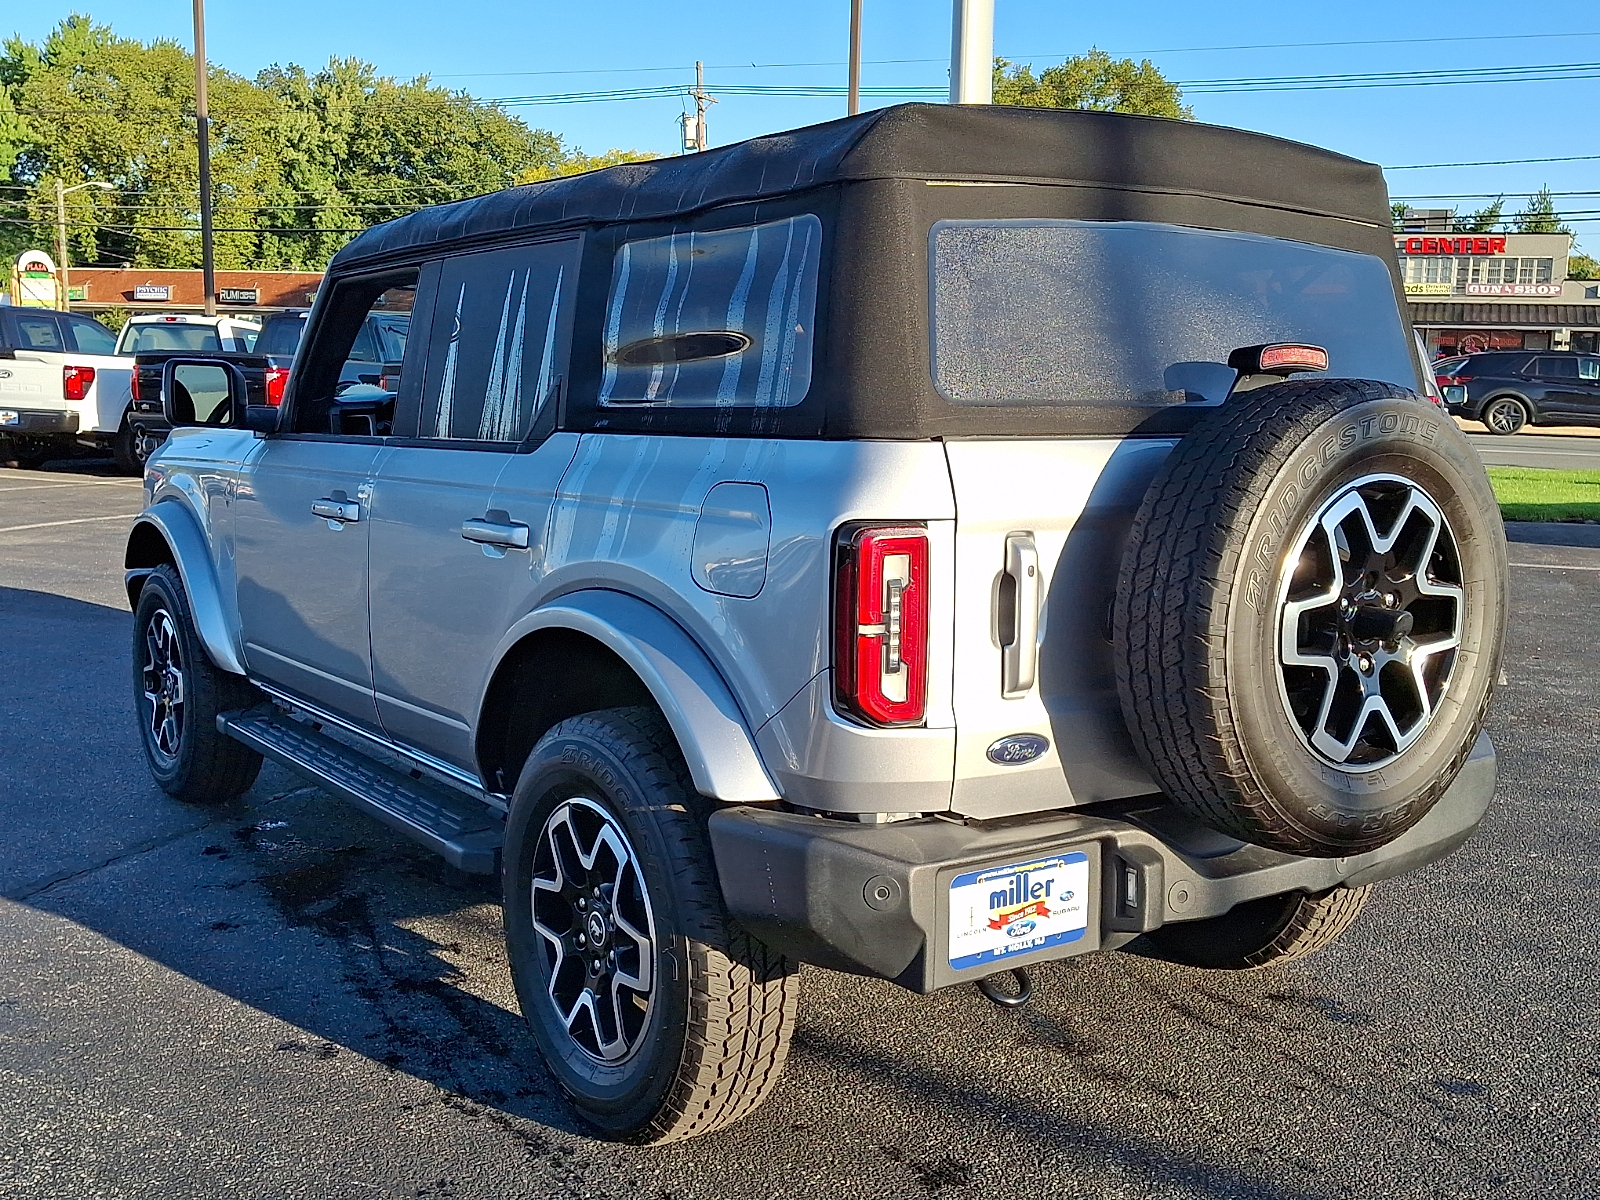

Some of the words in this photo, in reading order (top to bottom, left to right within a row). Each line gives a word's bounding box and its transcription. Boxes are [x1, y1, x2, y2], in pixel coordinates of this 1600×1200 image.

[1405, 237, 1507, 254] CENTER
[26, 263, 48, 271] PLAZA
[220, 289, 240, 300] RUMI
[1468, 285, 1503, 294] GUN
[1514, 285, 1561, 294] SHOP
[1245, 411, 1440, 615] BRIDGESTONE
[998, 738, 1041, 763] Ford
[989, 872, 1055, 910] miller
[1052, 905, 1080, 916] SUBARU
[956, 928, 987, 939] LINCOLN
[1010, 921, 1033, 937] Ford
[1034, 936, 1046, 946] NJ
